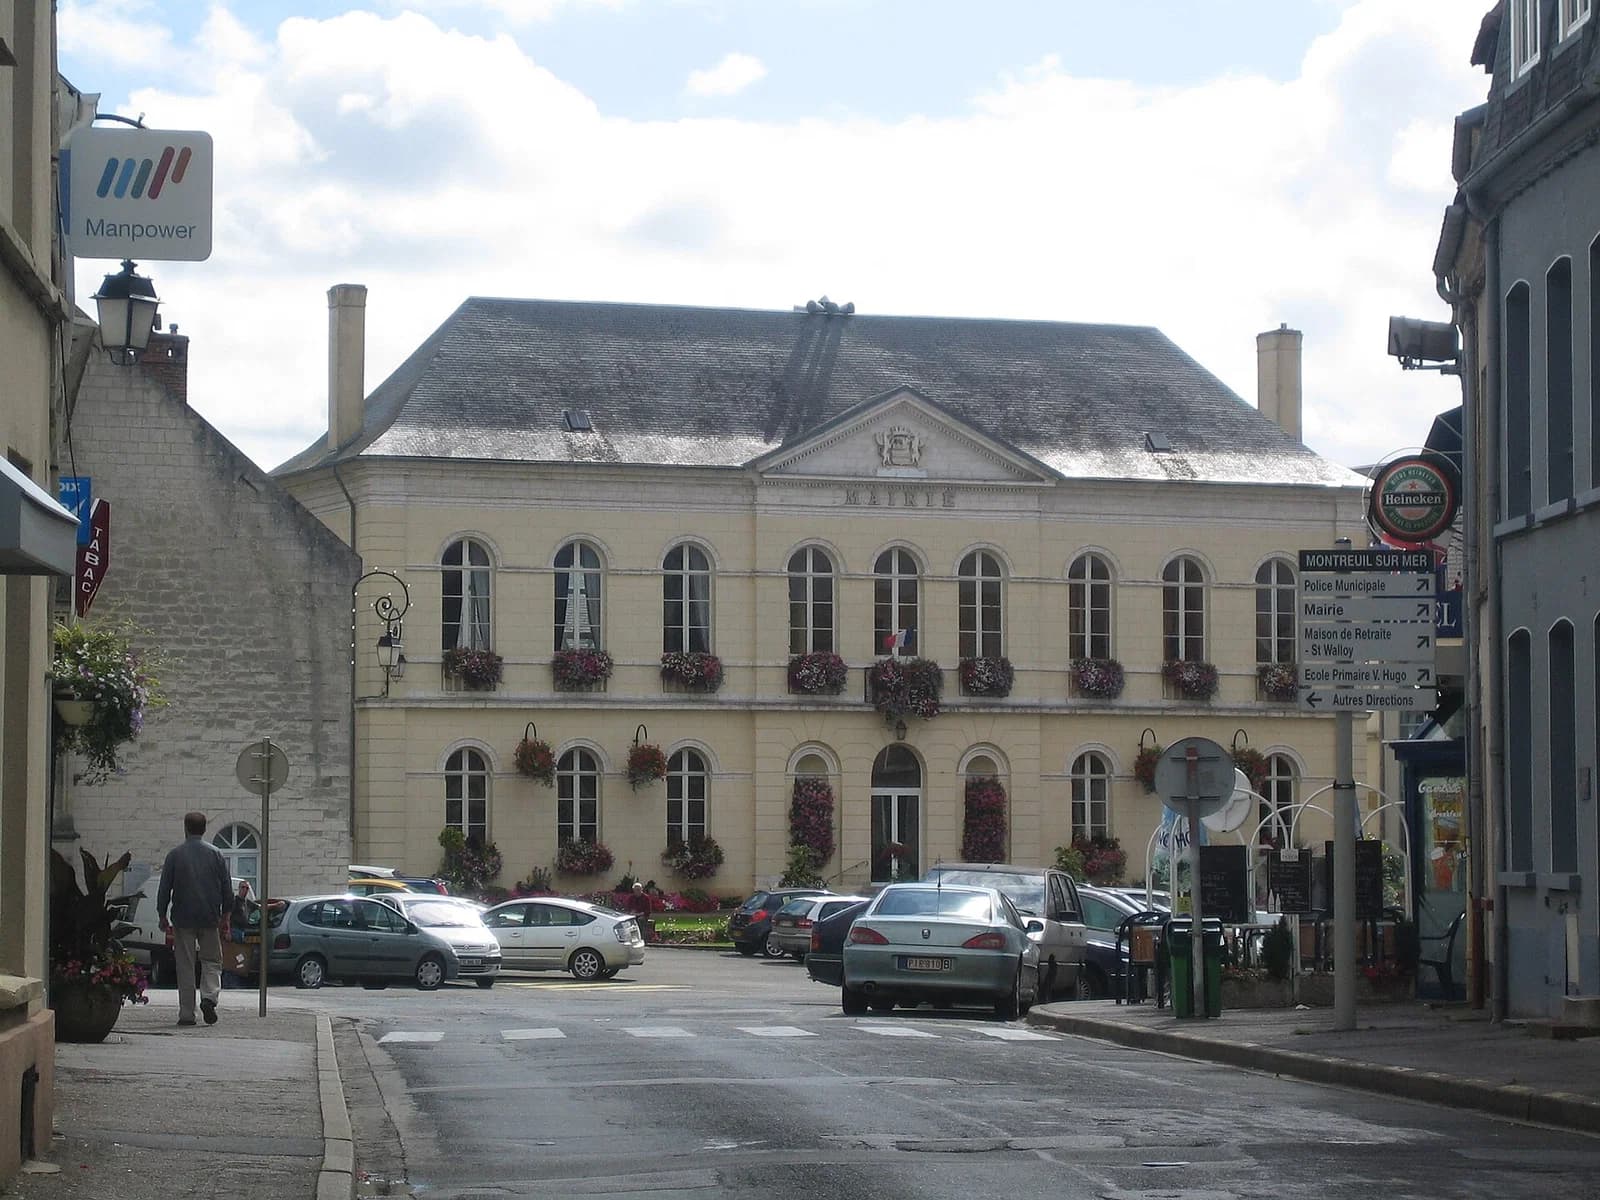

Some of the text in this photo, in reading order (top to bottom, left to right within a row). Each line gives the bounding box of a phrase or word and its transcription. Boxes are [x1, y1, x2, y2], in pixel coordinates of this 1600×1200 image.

[86, 219, 196, 242] Manpower
[845, 489, 955, 507] MAIRIE
[1385, 494, 1441, 505] Heineken
[82, 527, 103, 593] TABAC
[1306, 554, 1427, 567] MONTREUIL SUR MER
[1304, 579, 1386, 593] Police Municipale
[1304, 603, 1344, 616] Mairie
[1304, 628, 1391, 640] Maison de Retraite
[1311, 643, 1321, 656] St
[1324, 643, 1354, 658] Walloy
[1305, 668, 1407, 683] Ecole Primaire V. Hugo
[1333, 693, 1414, 706] Autres Directions
